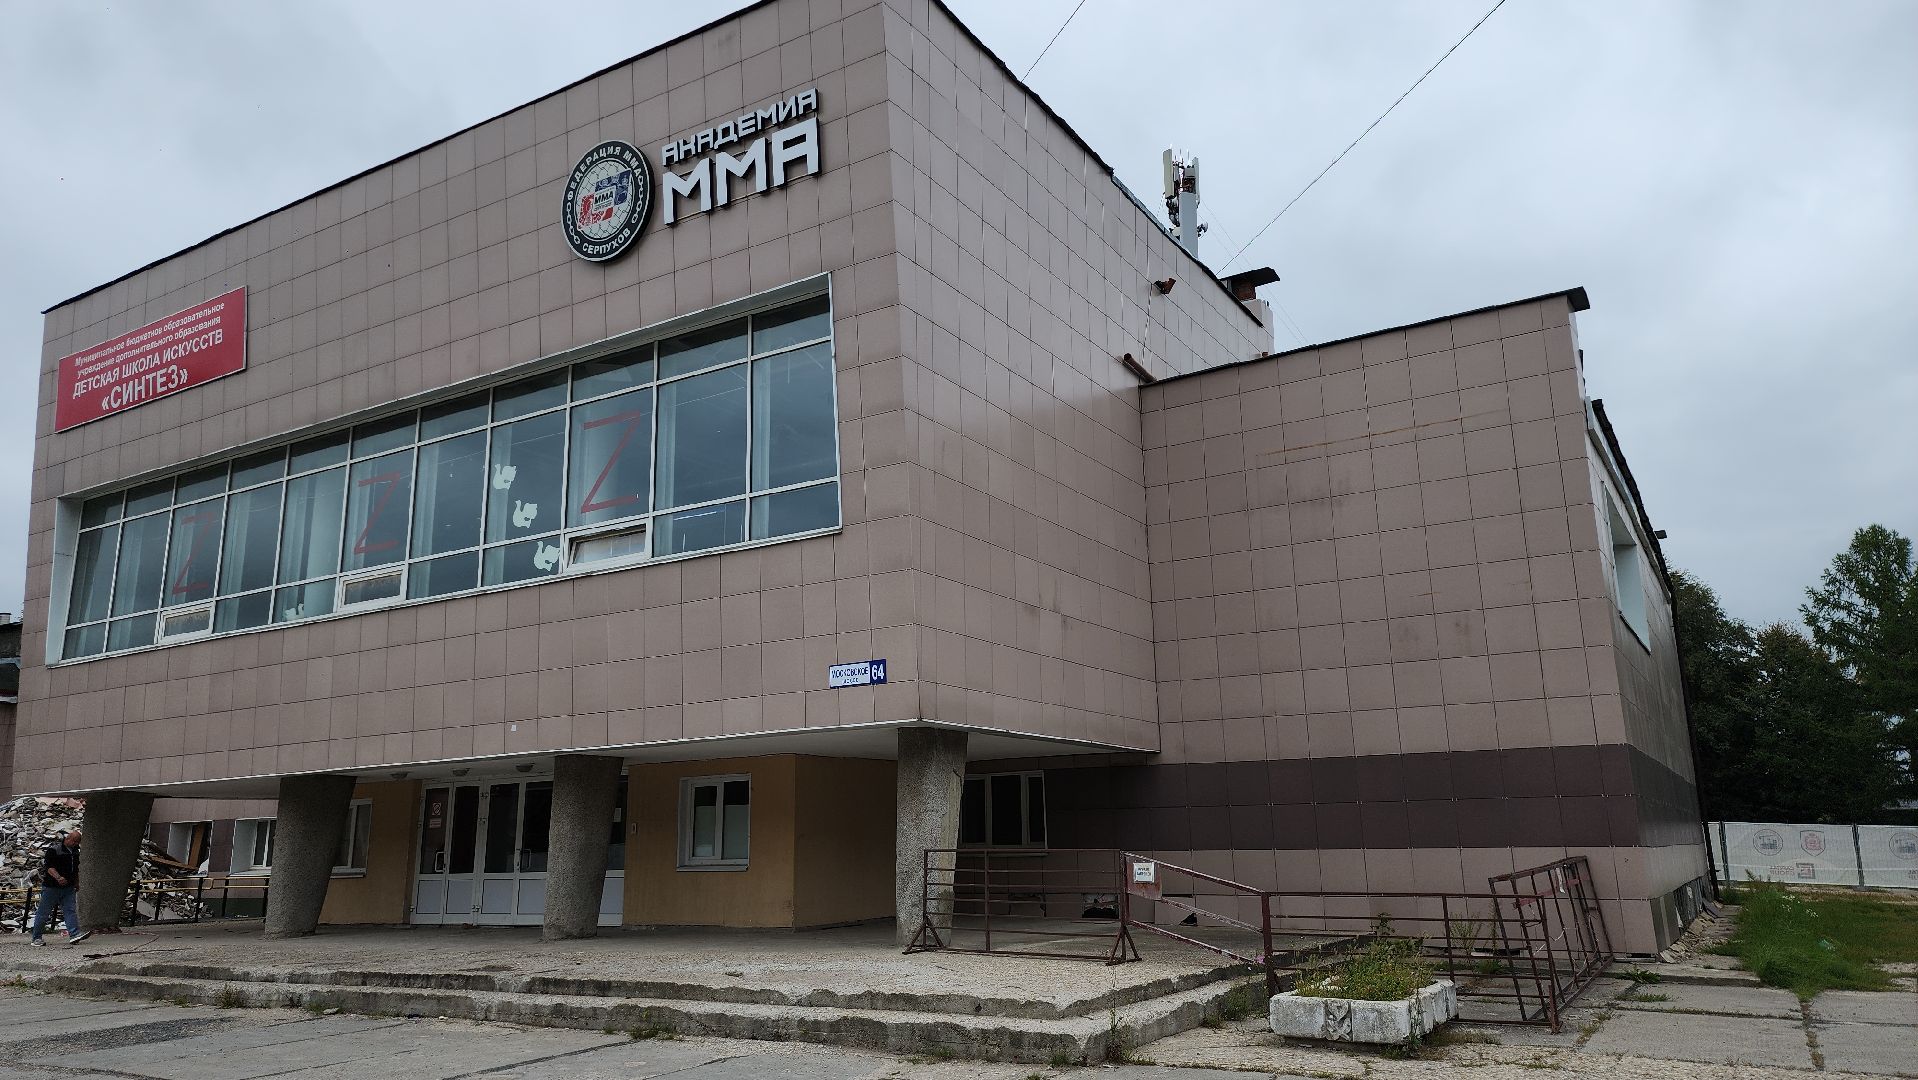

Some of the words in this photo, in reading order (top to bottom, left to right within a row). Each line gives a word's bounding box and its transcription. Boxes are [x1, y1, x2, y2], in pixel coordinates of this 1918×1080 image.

[661, 87, 819, 167] АКАДЕМИЯ
[567, 145, 622, 201] ФЕДЕРАЦИЯ
[622, 150, 643, 178] ММА
[662, 117, 821, 226] ММА
[582, 227, 632, 255] СЕРПУХОВ
[73, 366, 120, 400] ДЕТСКАЯ
[122, 352, 161, 379] ШКОЛА
[162, 328, 223, 364] ИСКУССТВ
[75, 342, 125, 367] Муниципальное
[126, 327, 163, 347] бюджетное
[163, 302, 225, 331] образовательное
[77, 357, 115, 379] учреждение
[115, 334, 173, 365] дополнительного
[174, 315, 221, 340] образования
[101, 364, 188, 411] «СИНТЕЗ»
[580, 410, 641, 514] Z
[354, 470, 400, 555] Z
[172, 510, 214, 596] Z
[871, 663, 885, 680] 64
